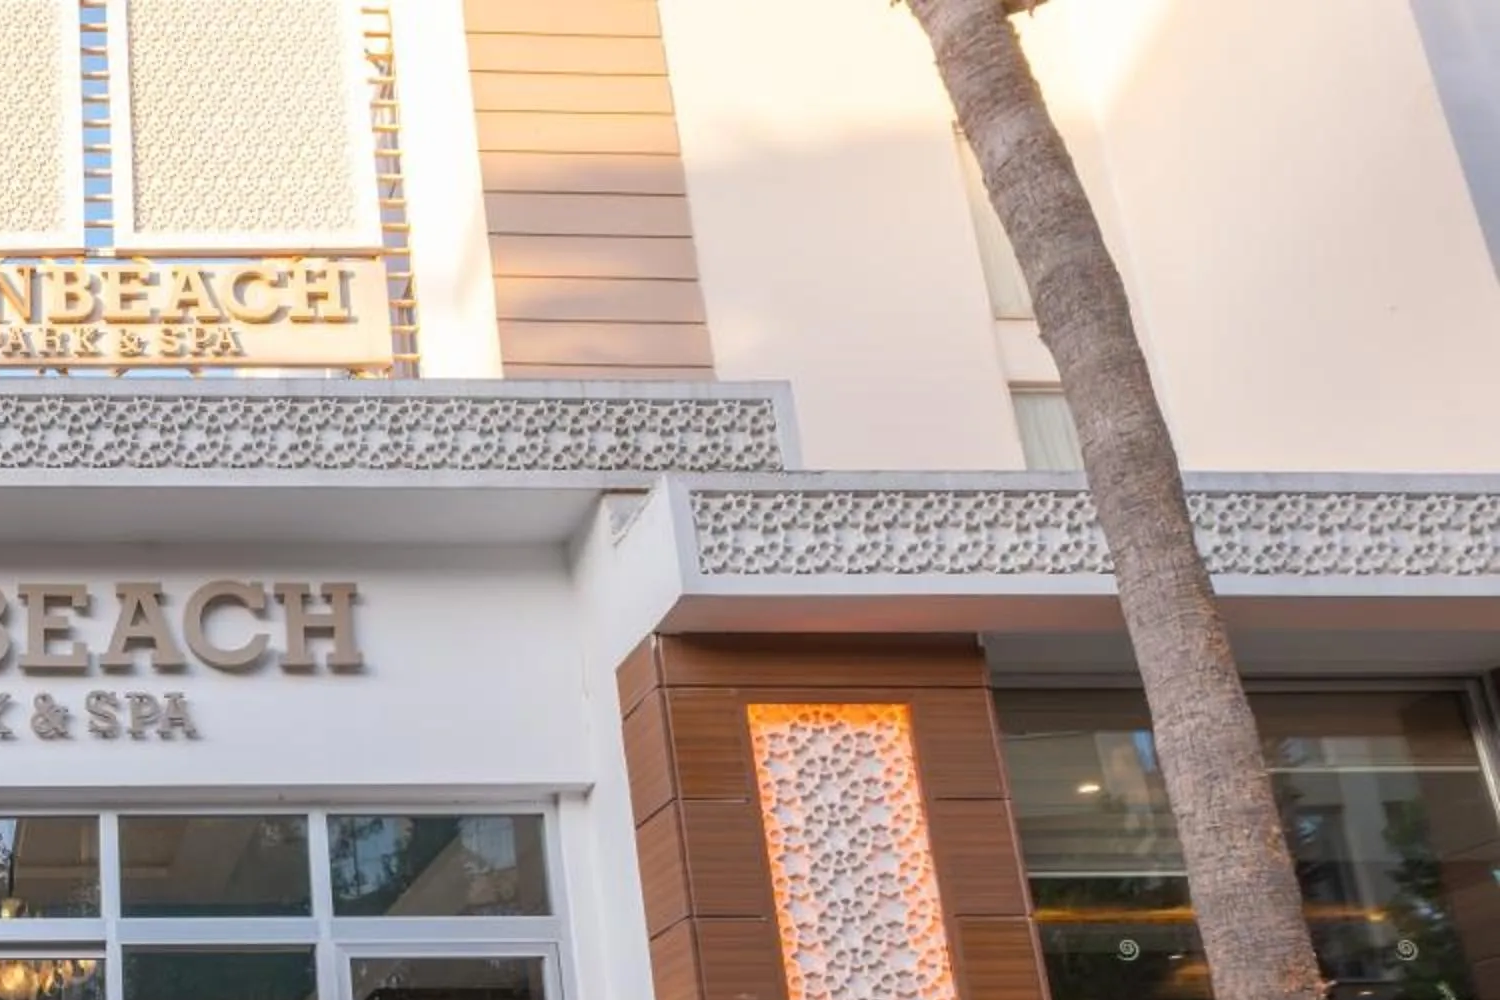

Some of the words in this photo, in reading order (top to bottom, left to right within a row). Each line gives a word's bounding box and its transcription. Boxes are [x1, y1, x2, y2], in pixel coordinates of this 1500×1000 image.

[118, 326, 151, 359] &
[160, 326, 244, 359] SPA
[30, 693, 72, 740] &
[87, 690, 201, 741] SPA
